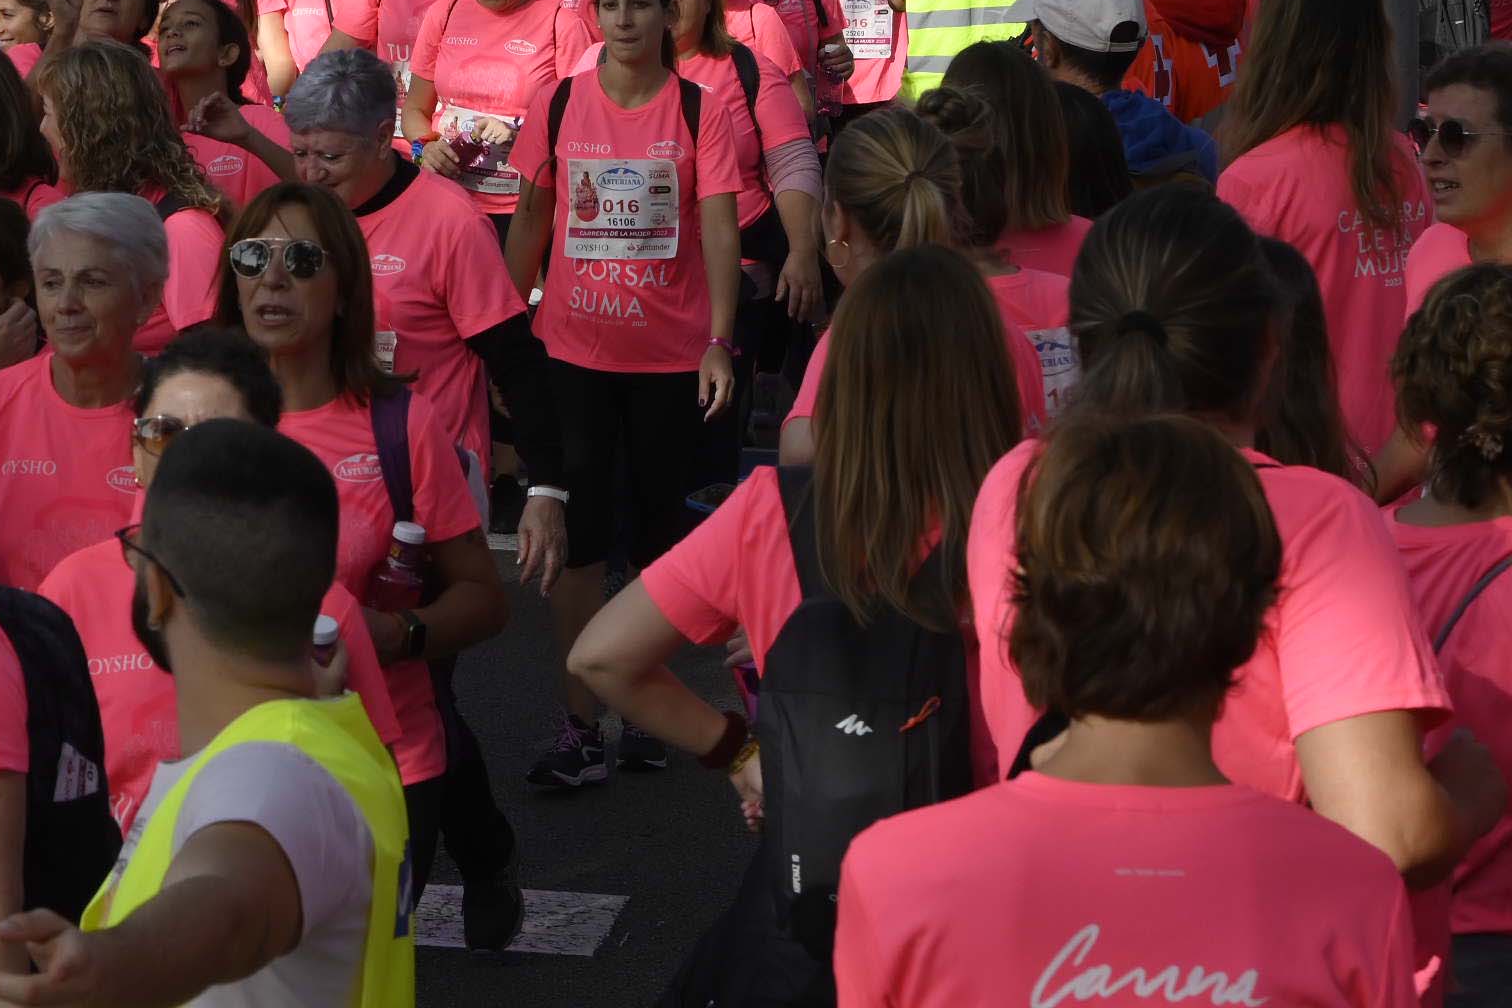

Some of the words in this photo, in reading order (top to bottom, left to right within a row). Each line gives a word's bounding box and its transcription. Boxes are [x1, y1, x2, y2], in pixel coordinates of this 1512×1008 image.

[446, 36, 480, 46] OYSHO
[568, 141, 612, 154] OYSHO
[599, 175, 644, 186] ASTURIANA
[602, 199, 640, 214] 016
[607, 217, 636, 227] 16106
[576, 243, 609, 252] OYSHO
[636, 244, 670, 252] Santander
[1354, 249, 1408, 278] MUJE
[568, 286, 645, 318] SUMA
[1, 460, 57, 476] OYSHO
[88, 652, 154, 676] OYSHO
[1030, 923, 1272, 1008] Carrera
